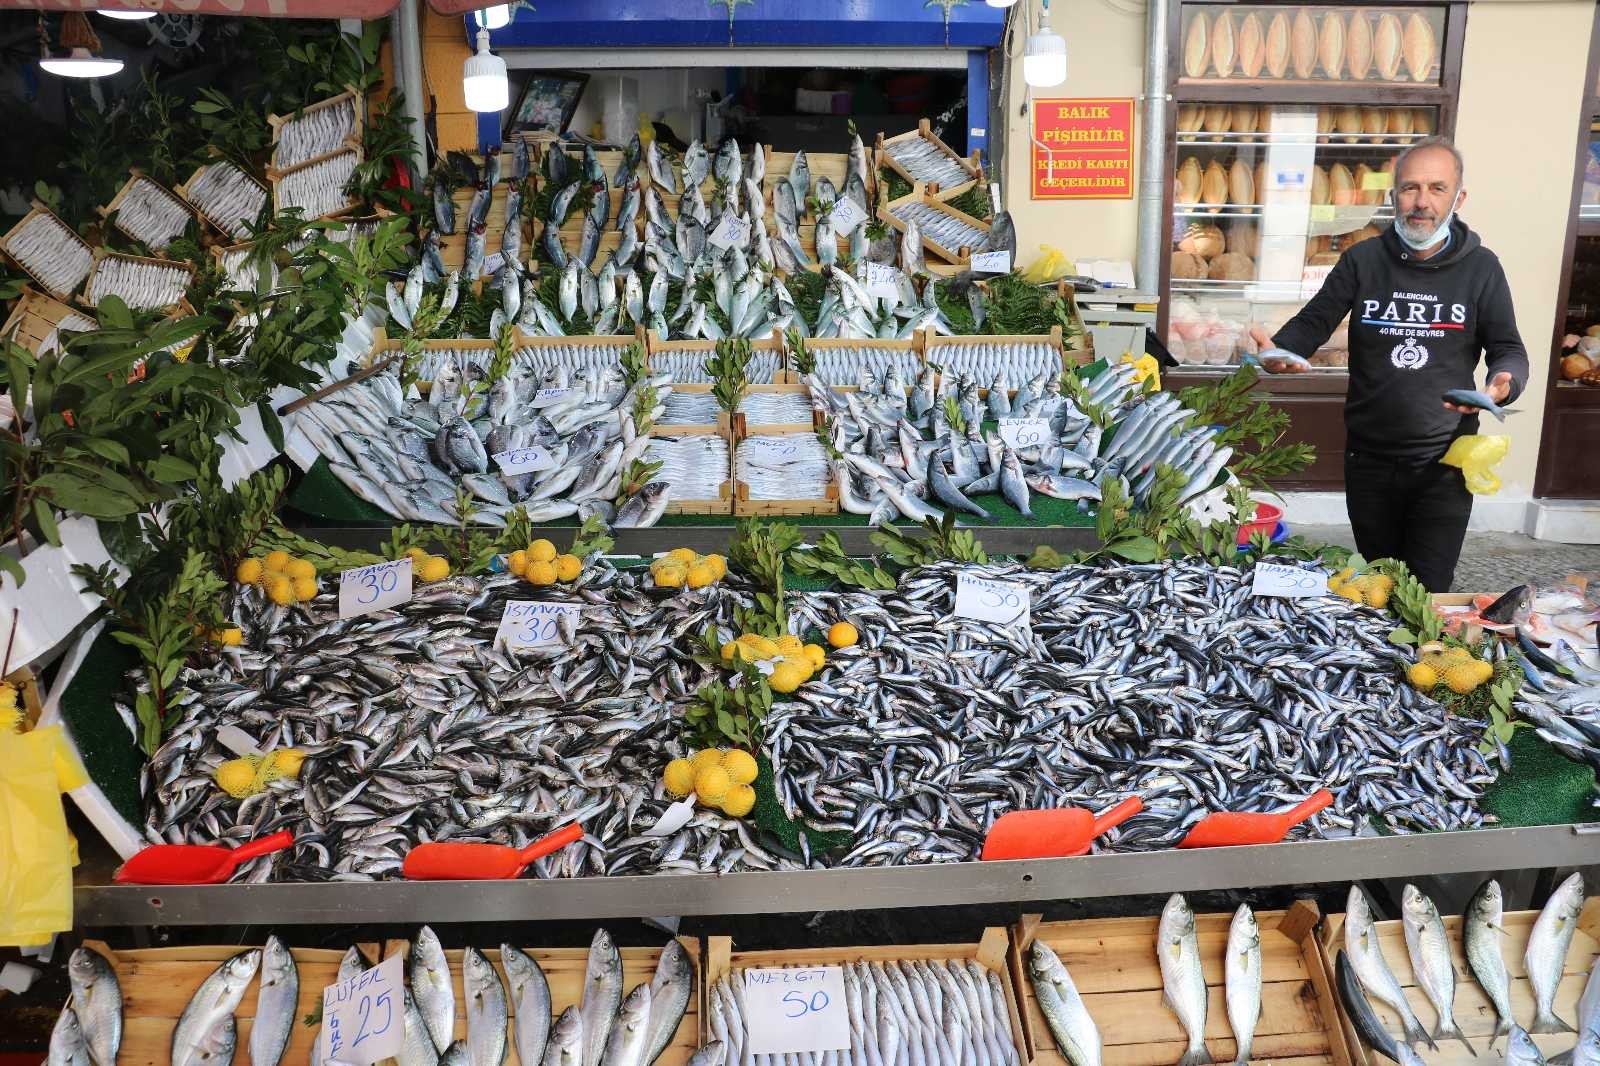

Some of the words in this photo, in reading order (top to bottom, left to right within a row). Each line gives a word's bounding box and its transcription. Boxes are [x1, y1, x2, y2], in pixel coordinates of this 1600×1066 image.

[1057, 106, 1110, 119] BALIK
[1042, 126, 1125, 144] PİŞİRİLİR
[1085, 159, 1129, 169] KARTI
[1393, 292, 1438, 302] BALENCIAGA
[1362, 300, 1466, 323] PARIS
[1379, 327, 1389, 335] 40
[1390, 328, 1405, 337] RUE
[1406, 329, 1415, 337] DE
[1416, 330, 1445, 338] SEVRES
[1015, 425, 1039, 446] 60
[510, 452, 538, 465] 60
[357, 568, 398, 604] 30
[518, 617, 558, 643] 30
[782, 990, 829, 1018] 50
[352, 988, 392, 1048] 25
